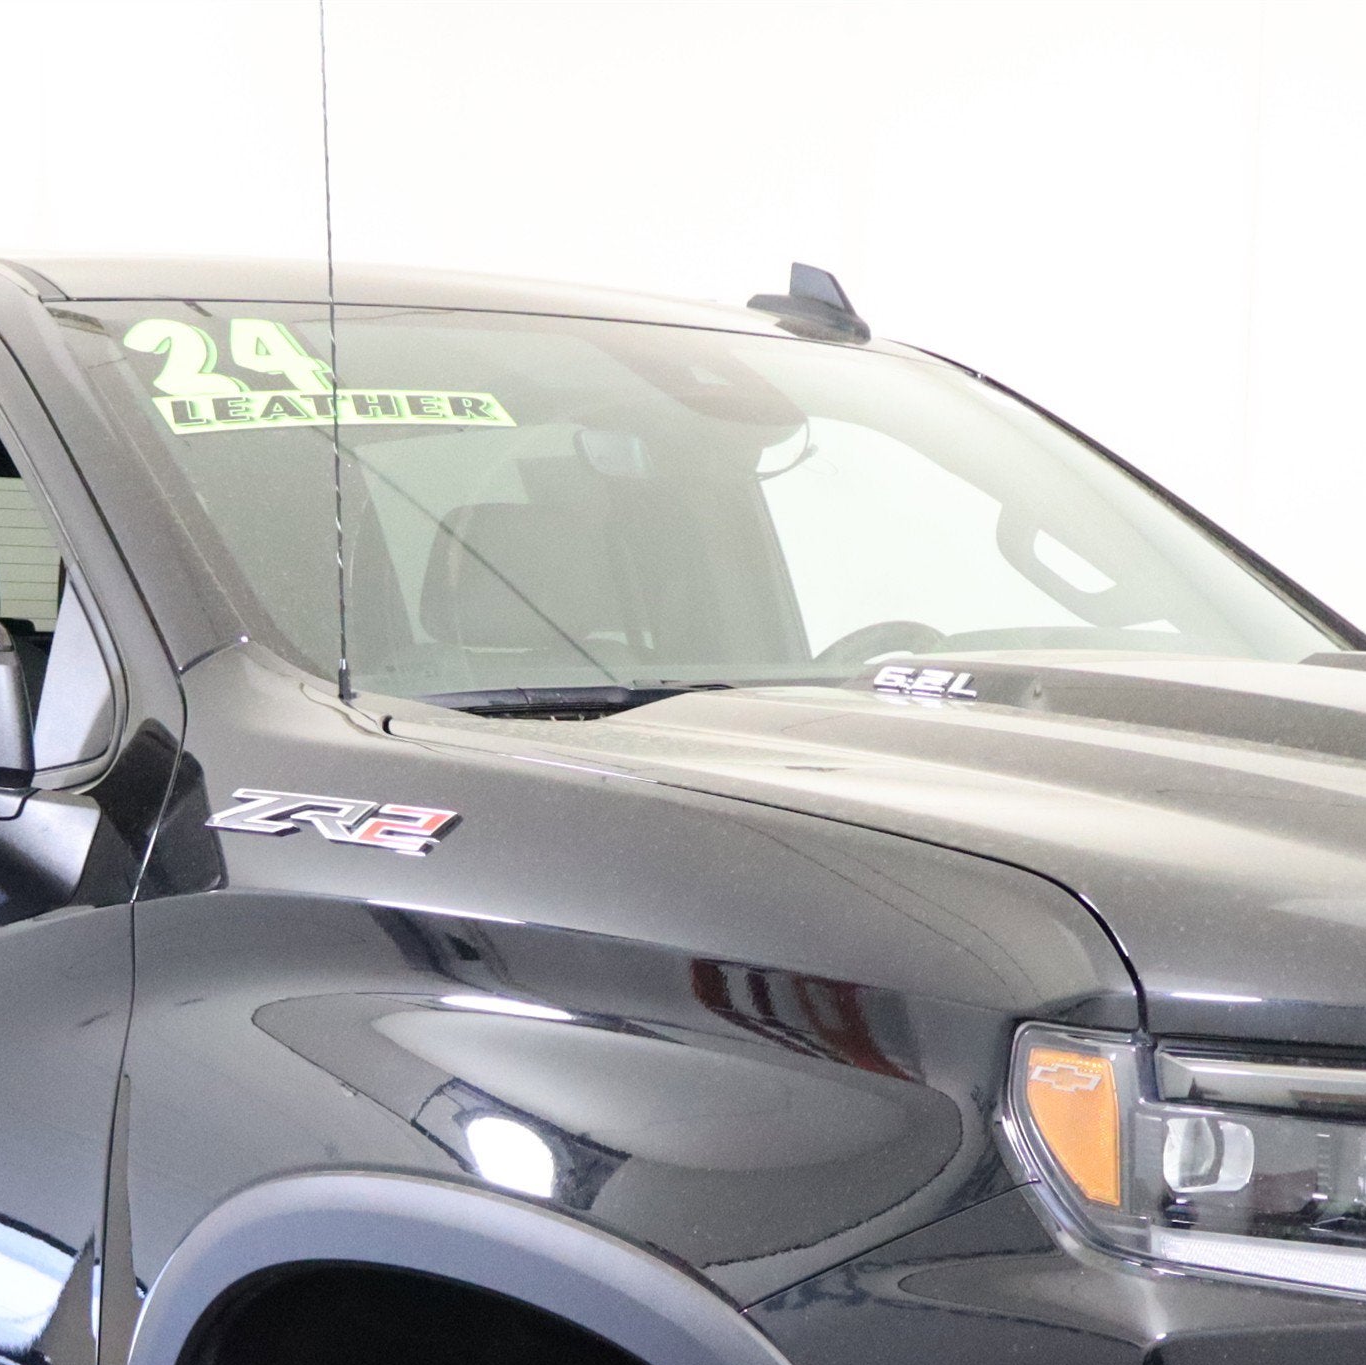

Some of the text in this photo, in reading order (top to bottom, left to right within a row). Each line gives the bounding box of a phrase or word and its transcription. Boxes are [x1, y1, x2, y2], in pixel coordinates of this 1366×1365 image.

[123, 317, 341, 396] 24
[170, 392, 507, 428] LEATHER
[205, 787, 461, 857] ZR2
